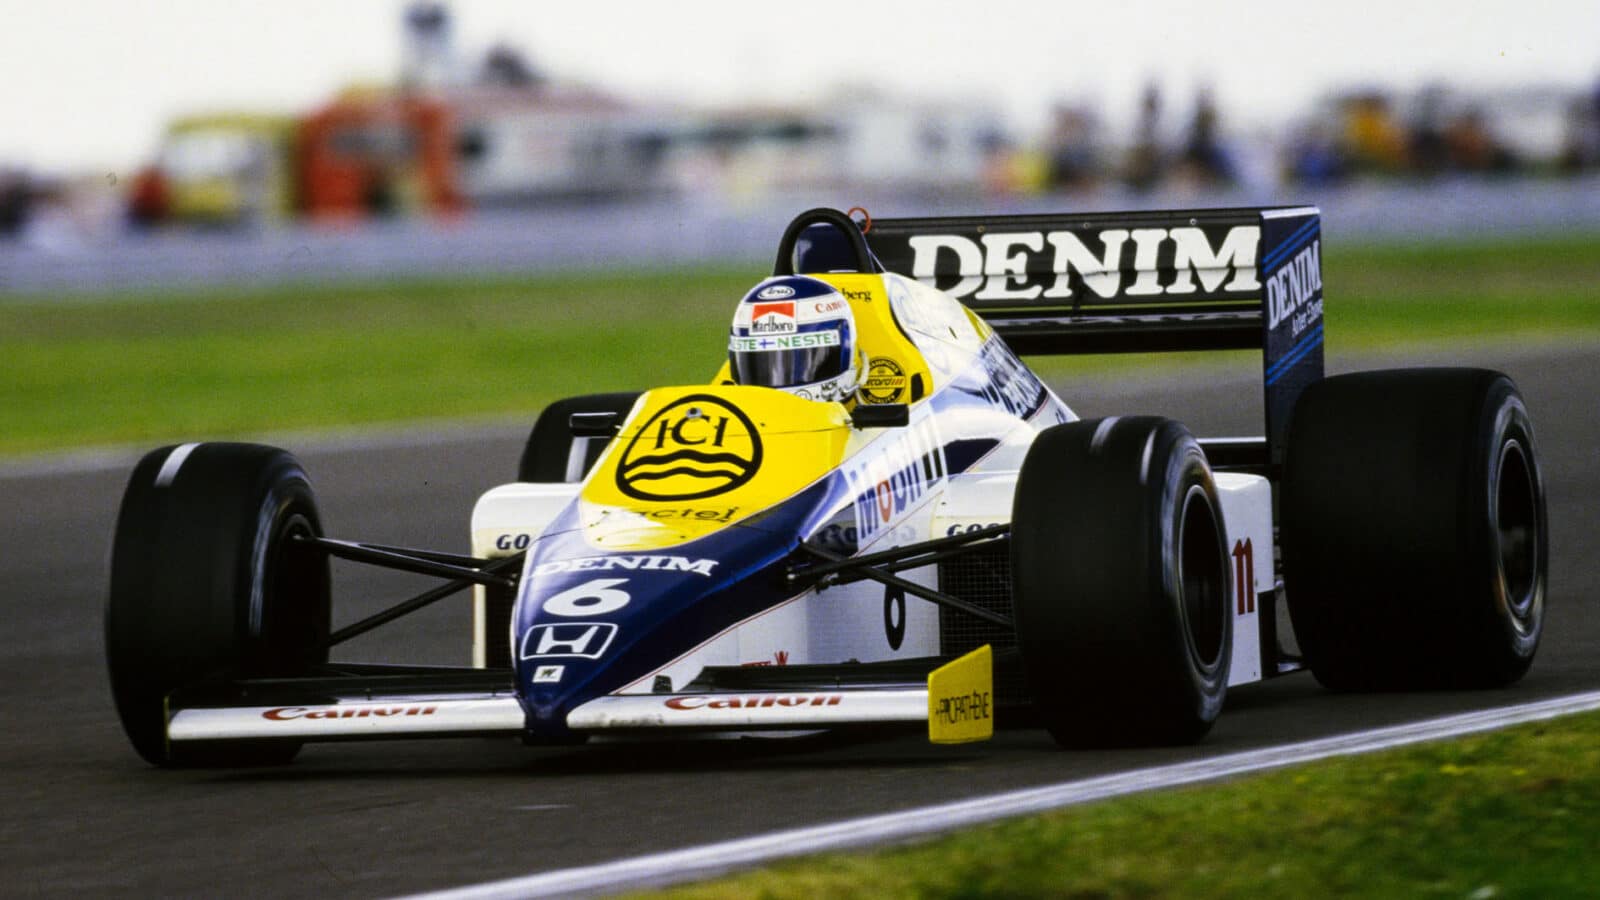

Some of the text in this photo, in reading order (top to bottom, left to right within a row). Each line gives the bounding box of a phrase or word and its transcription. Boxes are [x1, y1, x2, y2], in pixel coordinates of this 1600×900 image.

[908, 226, 1262, 300] DENIM
[1266, 240, 1322, 330] DENIM
[752, 315, 793, 332] Marlboro
[777, 332, 832, 348] NESTE
[653, 414, 728, 450] ICI
[857, 456, 922, 540] Mobil
[531, 555, 719, 577] DENIM
[1232, 537, 1254, 616] 11
[543, 578, 630, 617] 6
[262, 707, 438, 721] Canon
[664, 696, 843, 711] Canon
